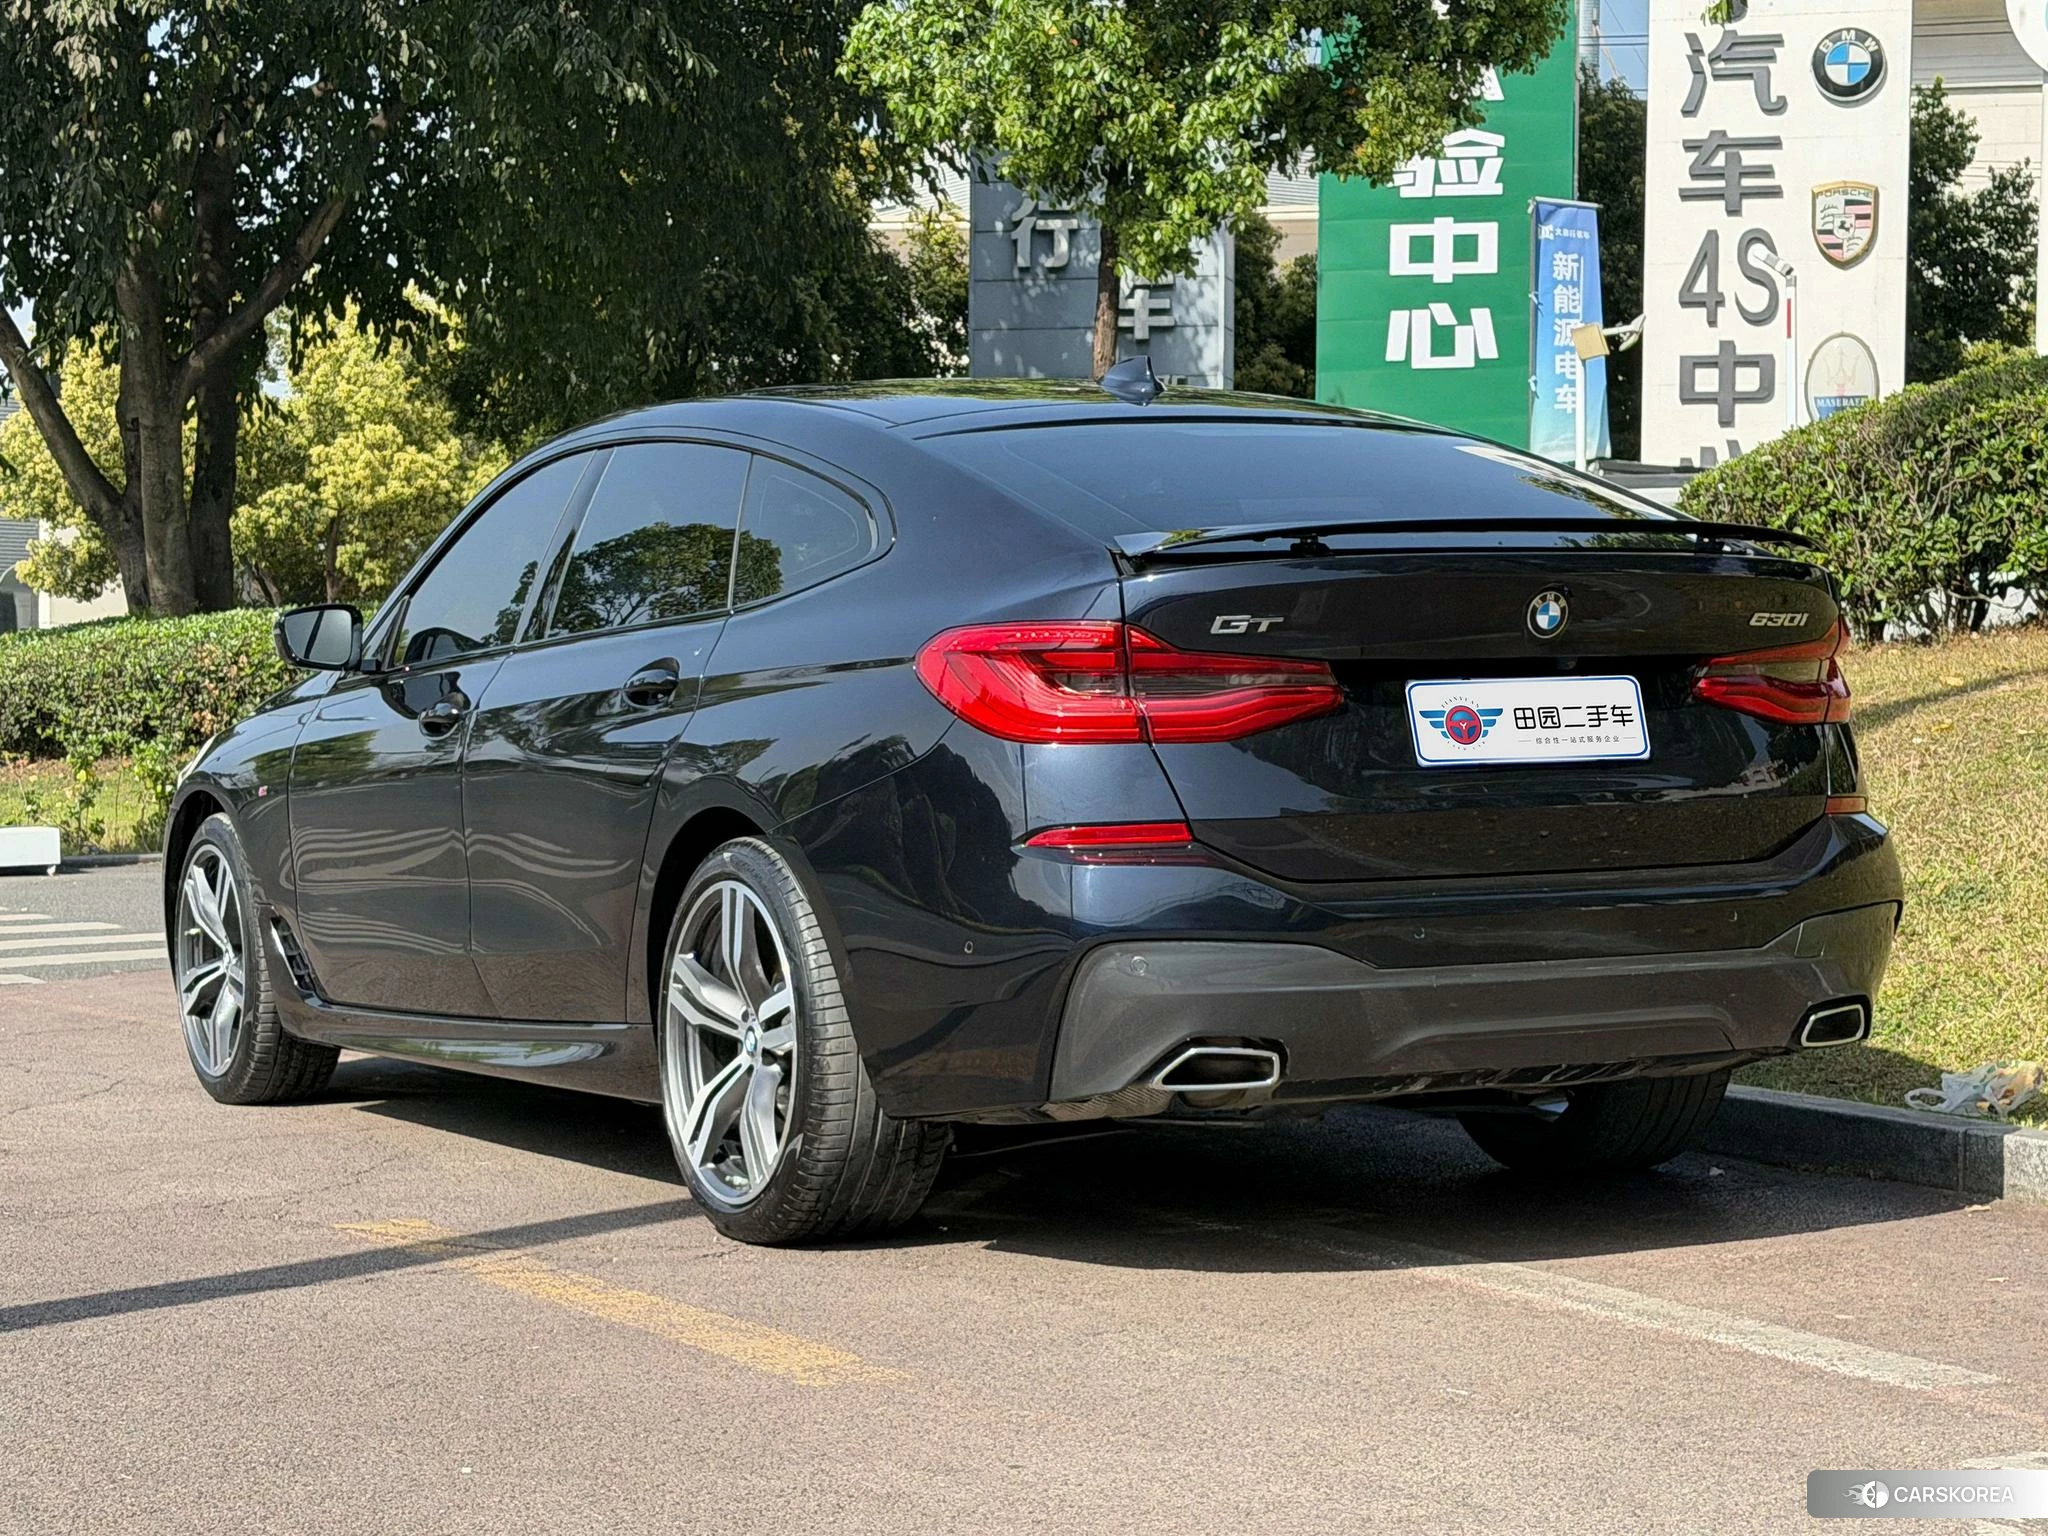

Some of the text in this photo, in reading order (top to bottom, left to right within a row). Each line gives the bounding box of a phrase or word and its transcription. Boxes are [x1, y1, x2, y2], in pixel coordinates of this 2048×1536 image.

[1819, 29, 1879, 53] BMW
[1210, 615, 1285, 634] GT
[1513, 704, 1634, 730] 田园二手车
